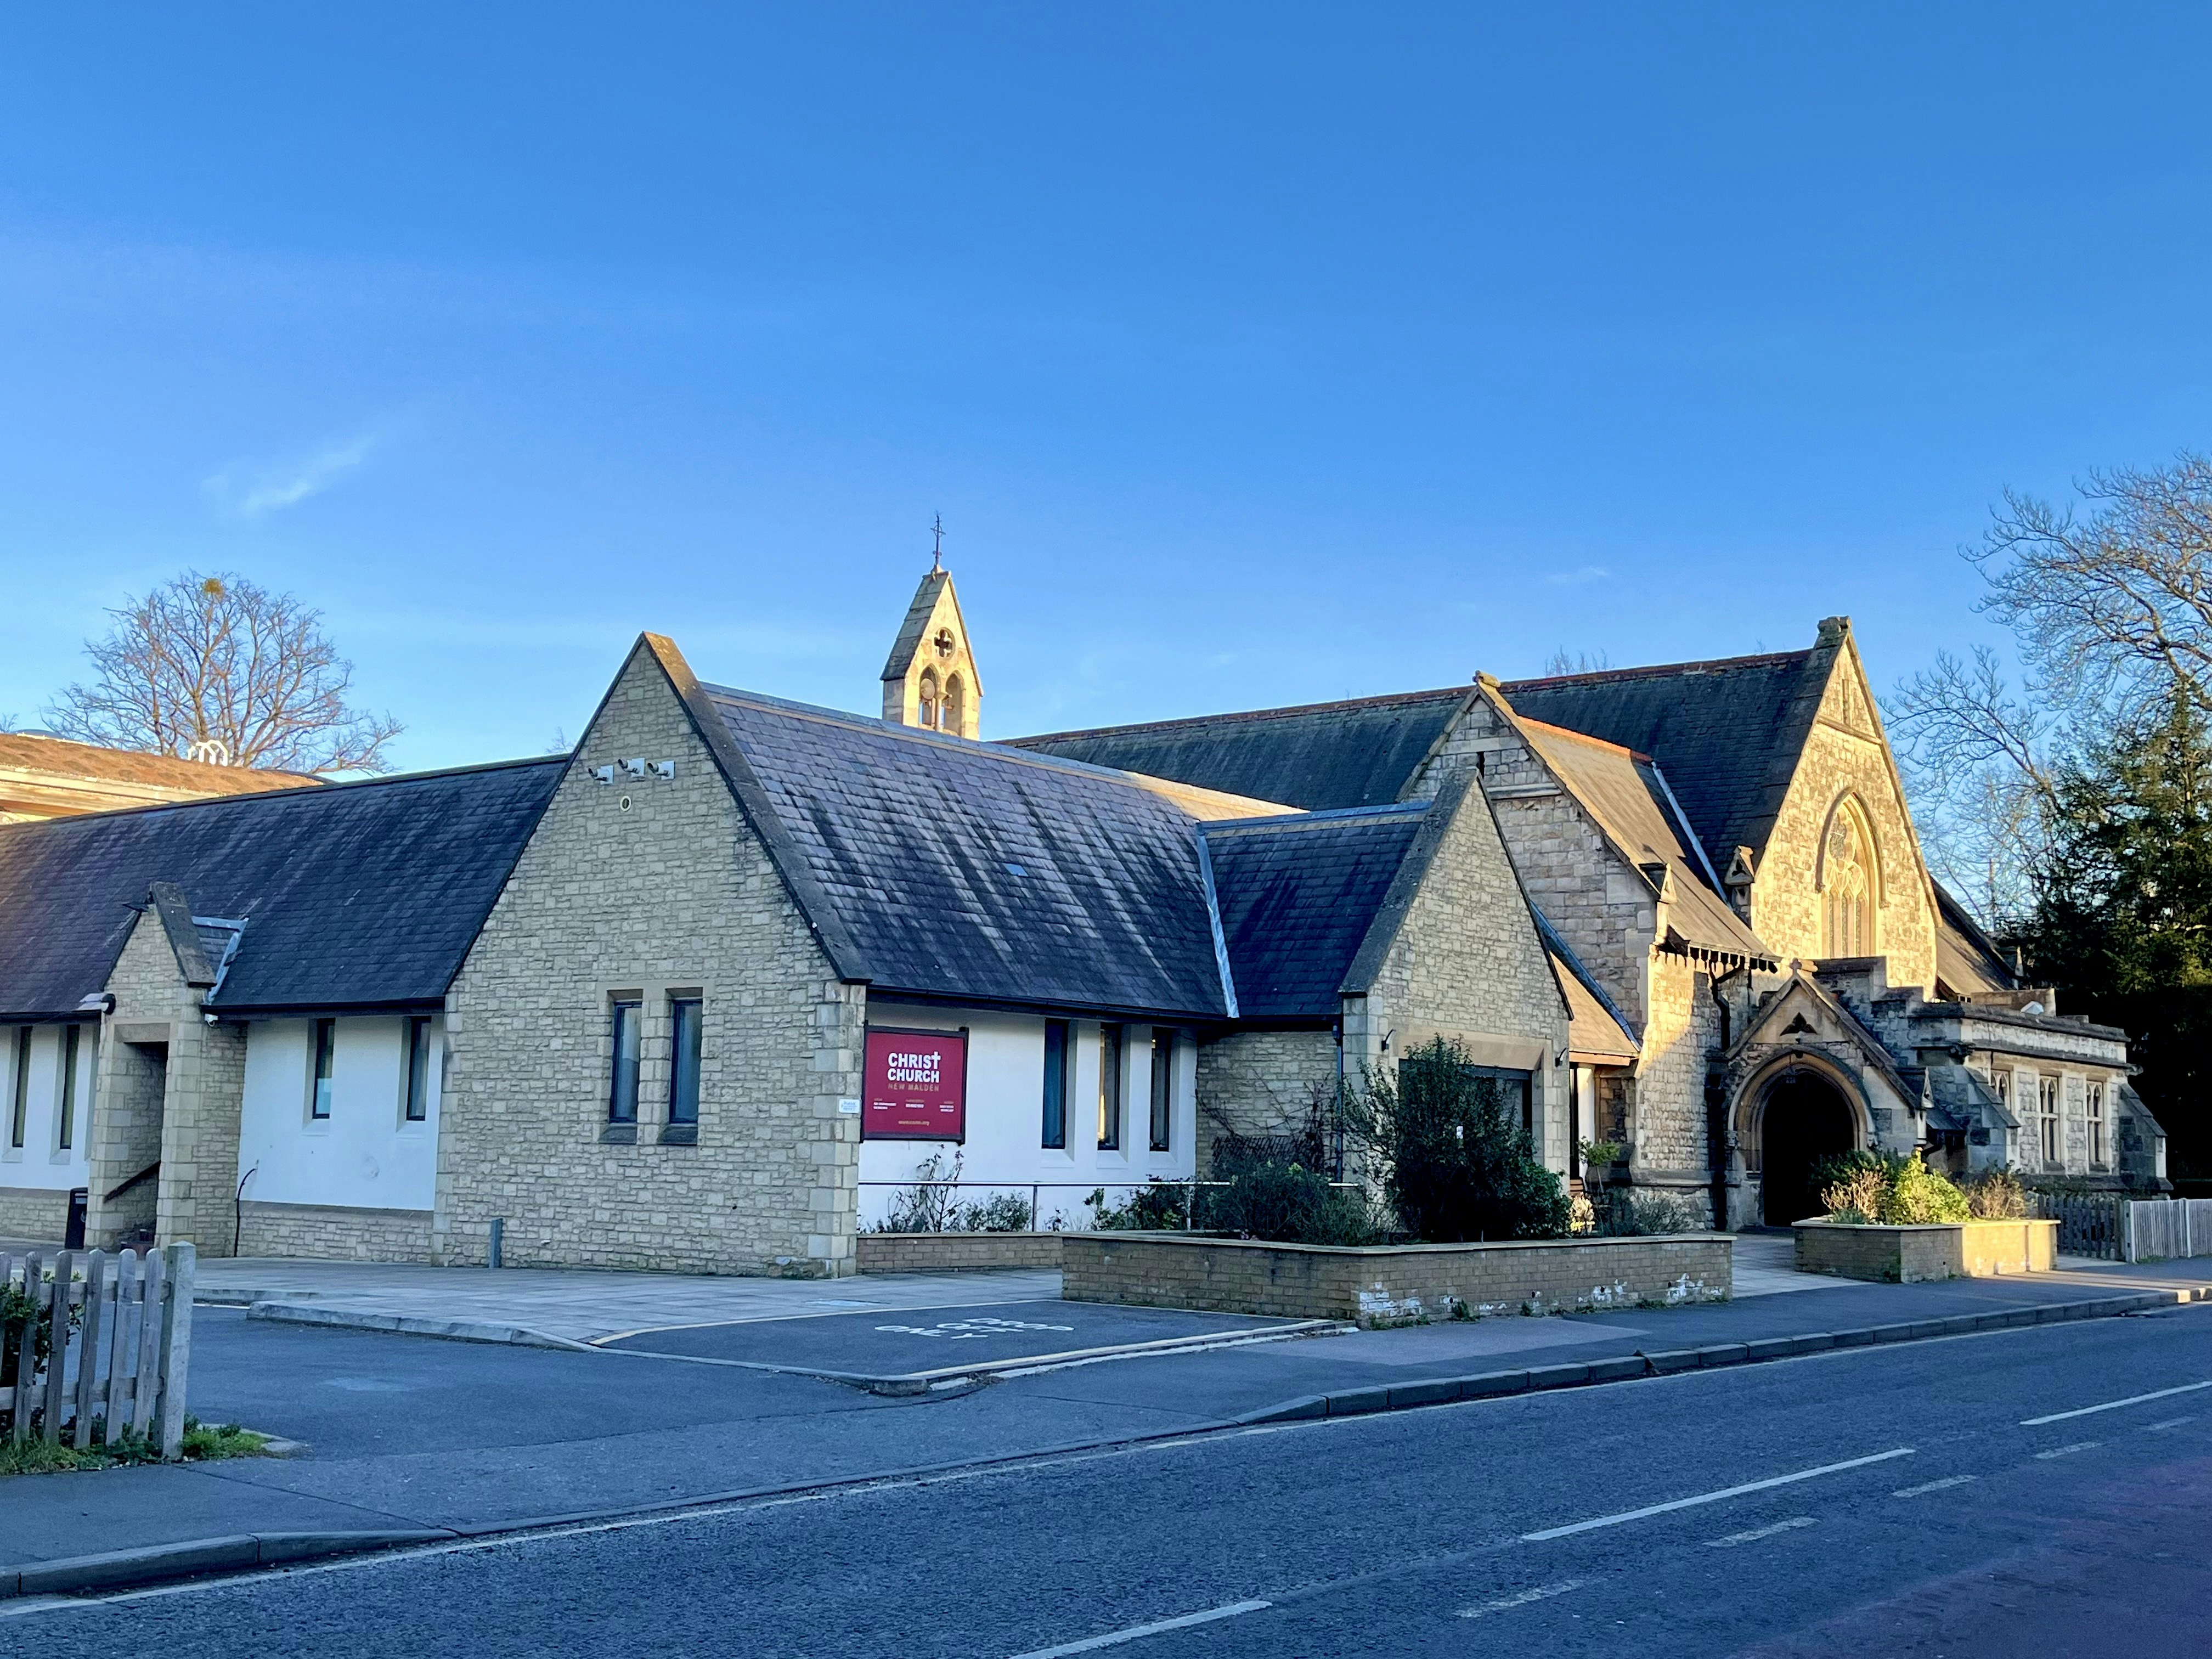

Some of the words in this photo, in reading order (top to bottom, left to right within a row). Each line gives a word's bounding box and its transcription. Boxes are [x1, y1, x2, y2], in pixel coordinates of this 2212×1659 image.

[888, 1051, 941, 1069] CHRIST
[888, 1069, 939, 1083] CHURCH
[908, 1084, 939, 1092] MALDEN
[936, 1323, 1024, 1333] OFF
[963, 1318, 1074, 1331] DROP
[874, 1325, 989, 1339] ONLY
